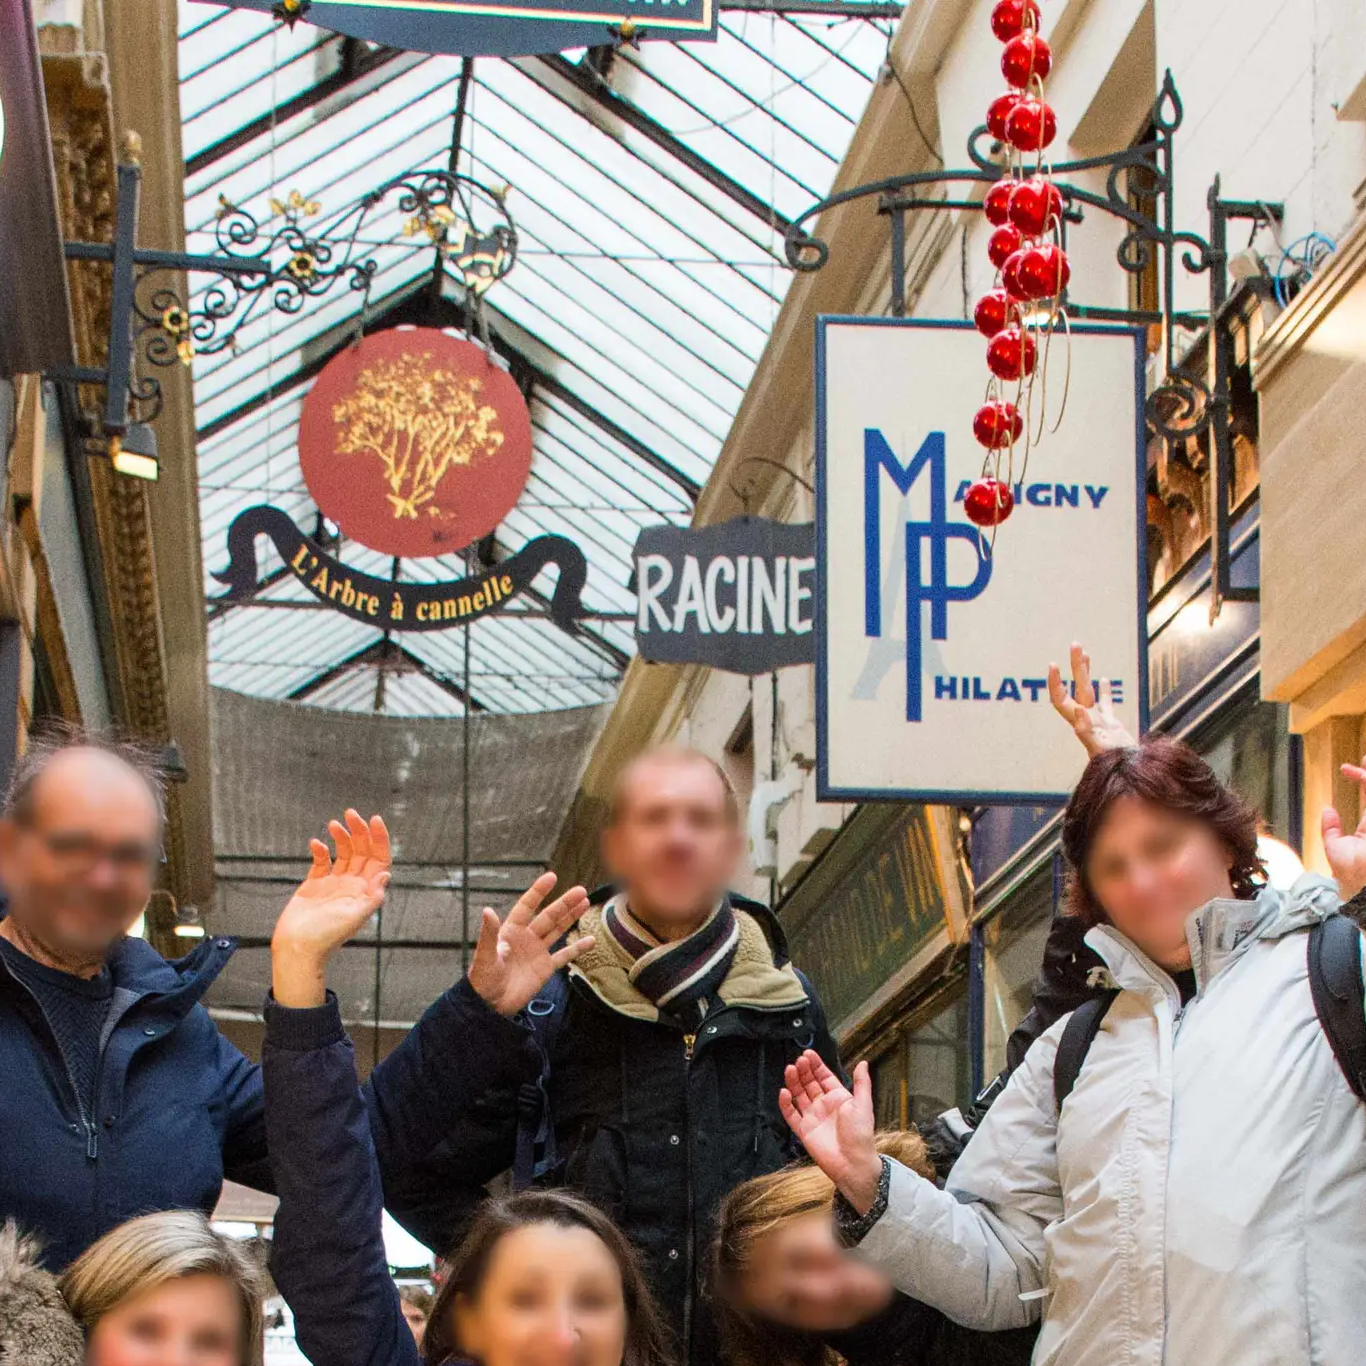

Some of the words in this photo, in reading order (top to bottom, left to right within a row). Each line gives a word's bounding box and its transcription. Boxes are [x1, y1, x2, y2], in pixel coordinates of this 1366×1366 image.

[953, 480, 1110, 509] AIGNY
[291, 543, 381, 616] L'Arbre
[390, 592, 404, 620] à
[415, 575, 514, 621] cannelle
[638, 554, 814, 634] RACINE
